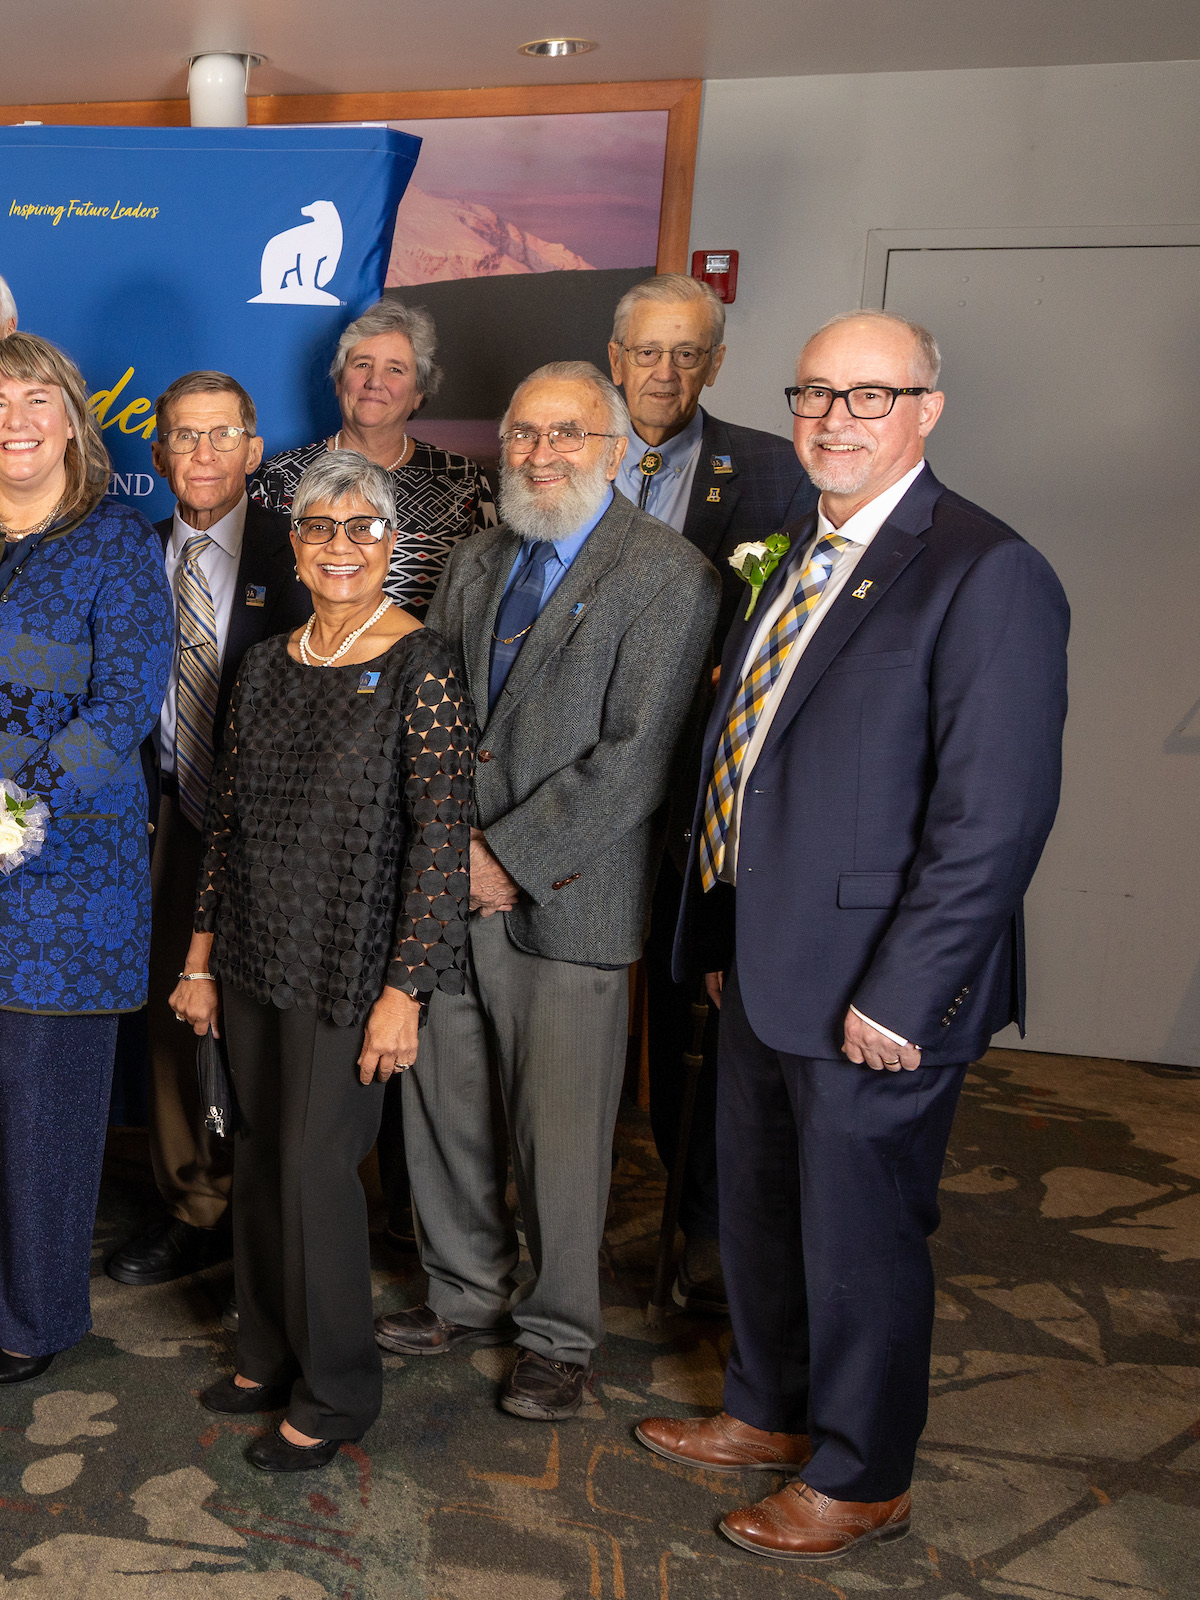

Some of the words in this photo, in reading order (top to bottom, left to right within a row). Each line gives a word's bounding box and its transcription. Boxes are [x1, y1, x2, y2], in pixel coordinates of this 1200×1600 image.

[8, 199, 66, 226] Inspiring
[67, 199, 111, 218] Future
[110, 200, 160, 220] Leaders
